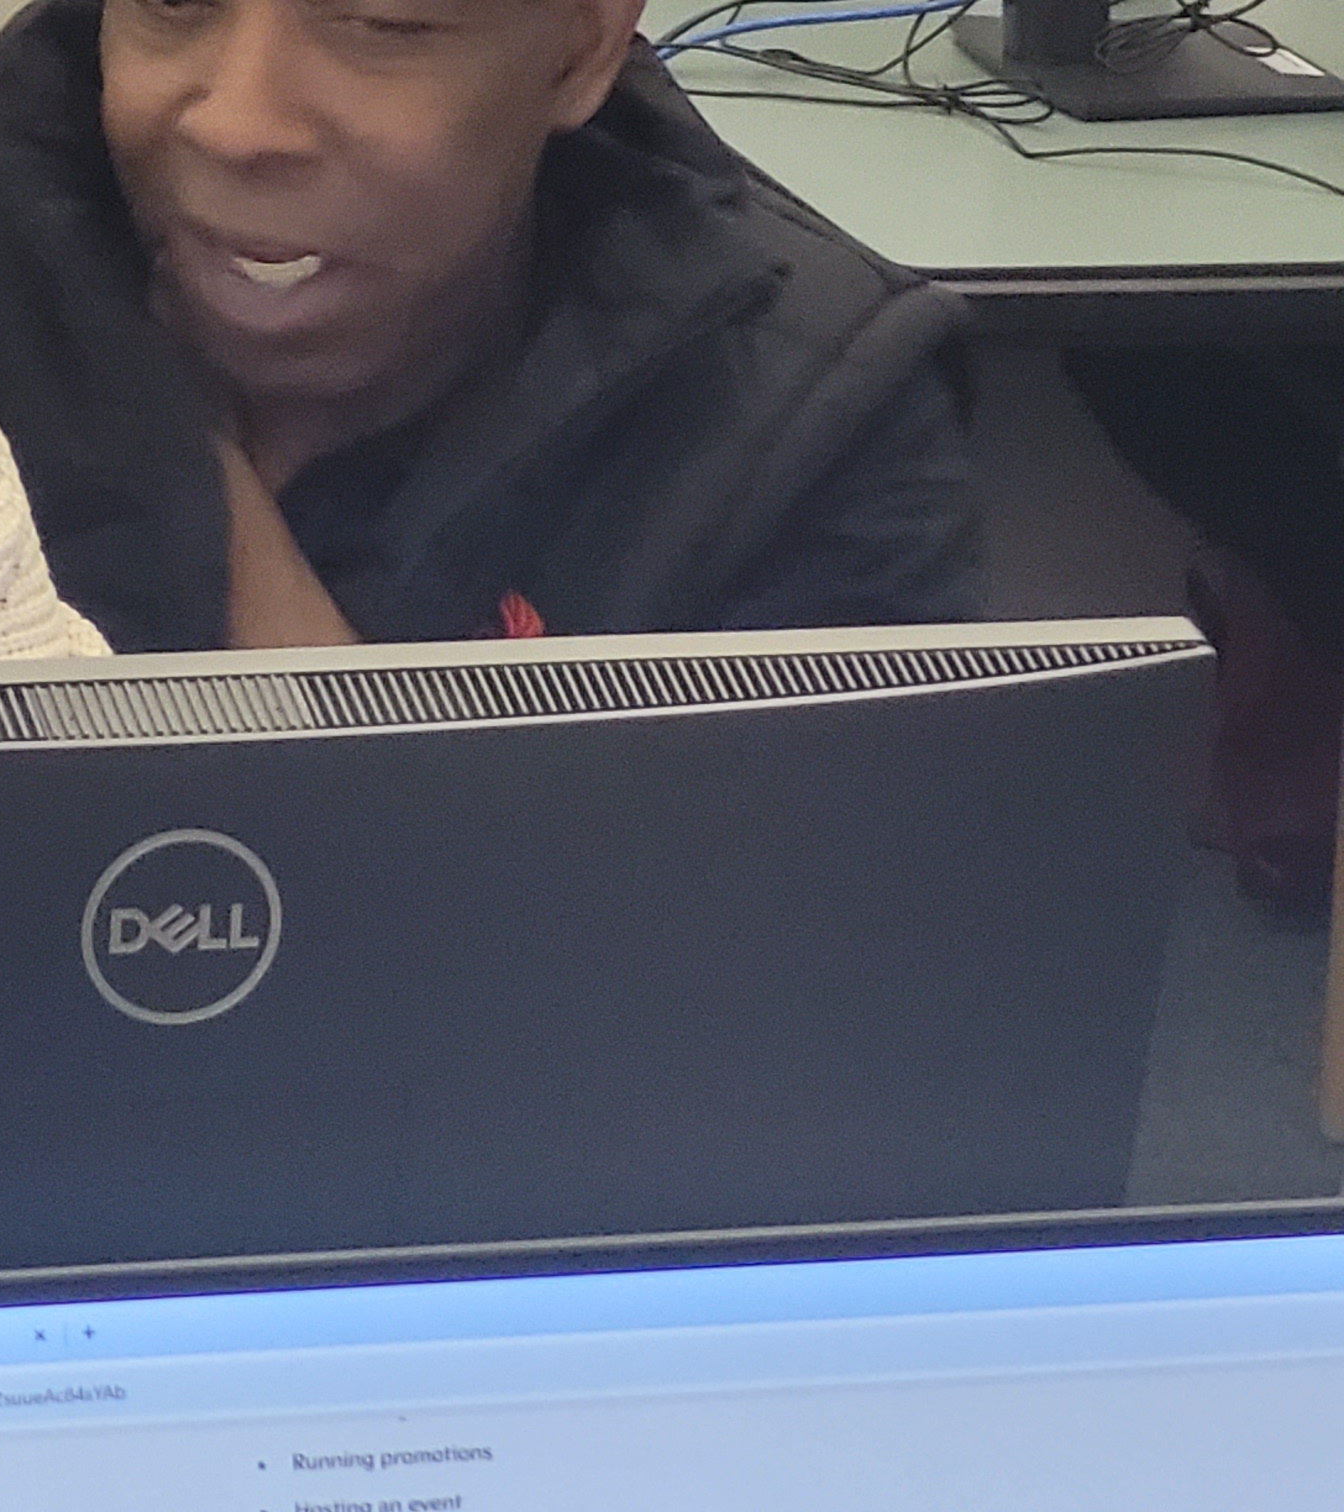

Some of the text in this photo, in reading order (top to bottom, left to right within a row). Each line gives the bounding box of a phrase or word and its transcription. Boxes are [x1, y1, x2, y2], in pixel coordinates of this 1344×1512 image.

[108, 902, 260, 954] DELL
[291, 1444, 494, 1472] Running promotions
[294, 1494, 462, 1512] Hosting an event
